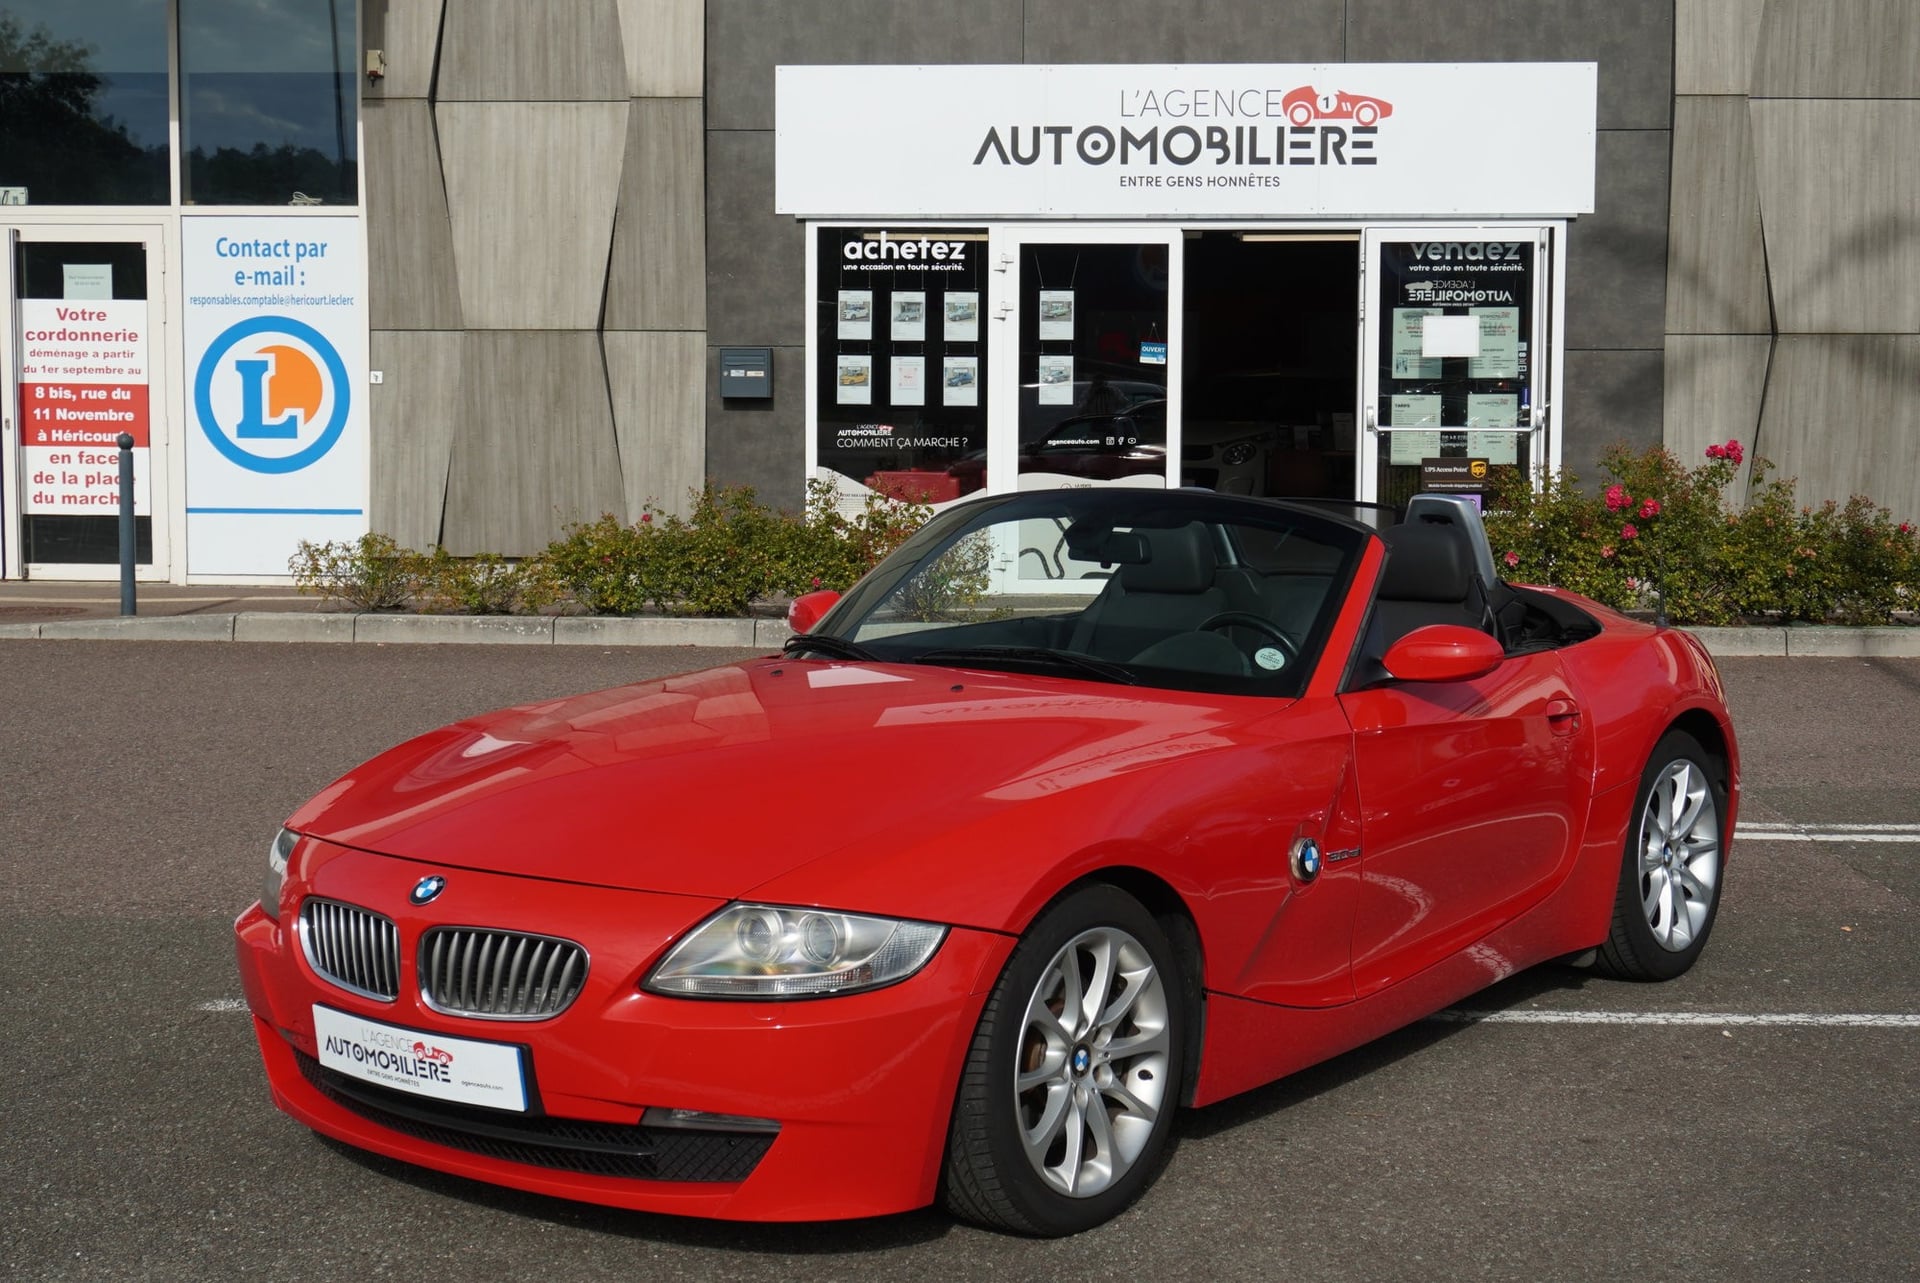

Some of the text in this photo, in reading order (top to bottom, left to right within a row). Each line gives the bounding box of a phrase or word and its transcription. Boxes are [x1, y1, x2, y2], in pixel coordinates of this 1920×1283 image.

[1120, 89, 1281, 118] L'AGENCE
[973, 125, 1378, 166] AUTOMOBILIERE
[1120, 172, 1280, 188] ENTRE GENS HONNÊTES
[215, 236, 328, 263] Contact par
[843, 231, 966, 260] achetez
[860, 262, 893, 271] occasion
[907, 263, 929, 271] toute
[931, 262, 965, 271] sécurité.
[1409, 264, 1430, 272] votre
[1432, 264, 1451, 272] auto
[1466, 264, 1487, 272] toute
[1490, 262, 1525, 272] sérénité.
[234, 264, 295, 286] e-mail
[189, 293, 354, 307] responsables.comptable@hericourt.leclerc
[56, 307, 108, 322] Votre
[25, 328, 139, 343] cordonnerie
[29, 349, 89, 360] déménage
[103, 350, 136, 360] partir
[23, 365, 142, 376] du 1er septembre au
[35, 386, 132, 402] 8 bis, rue du
[33, 407, 136, 422] 11 Novembre
[37, 429, 47, 443] à
[836, 437, 968, 450] COMMENT ÇA MARCHE ?
[1047, 438, 1100, 447] agenceauto.com
[49, 451, 120, 464] en face
[33, 471, 55, 485] de
[62, 471, 79, 485] la
[33, 490, 55, 505] du
[361, 1028, 414, 1053] L'AGENCE
[325, 1034, 451, 1083] AUTOMOBILIERE
